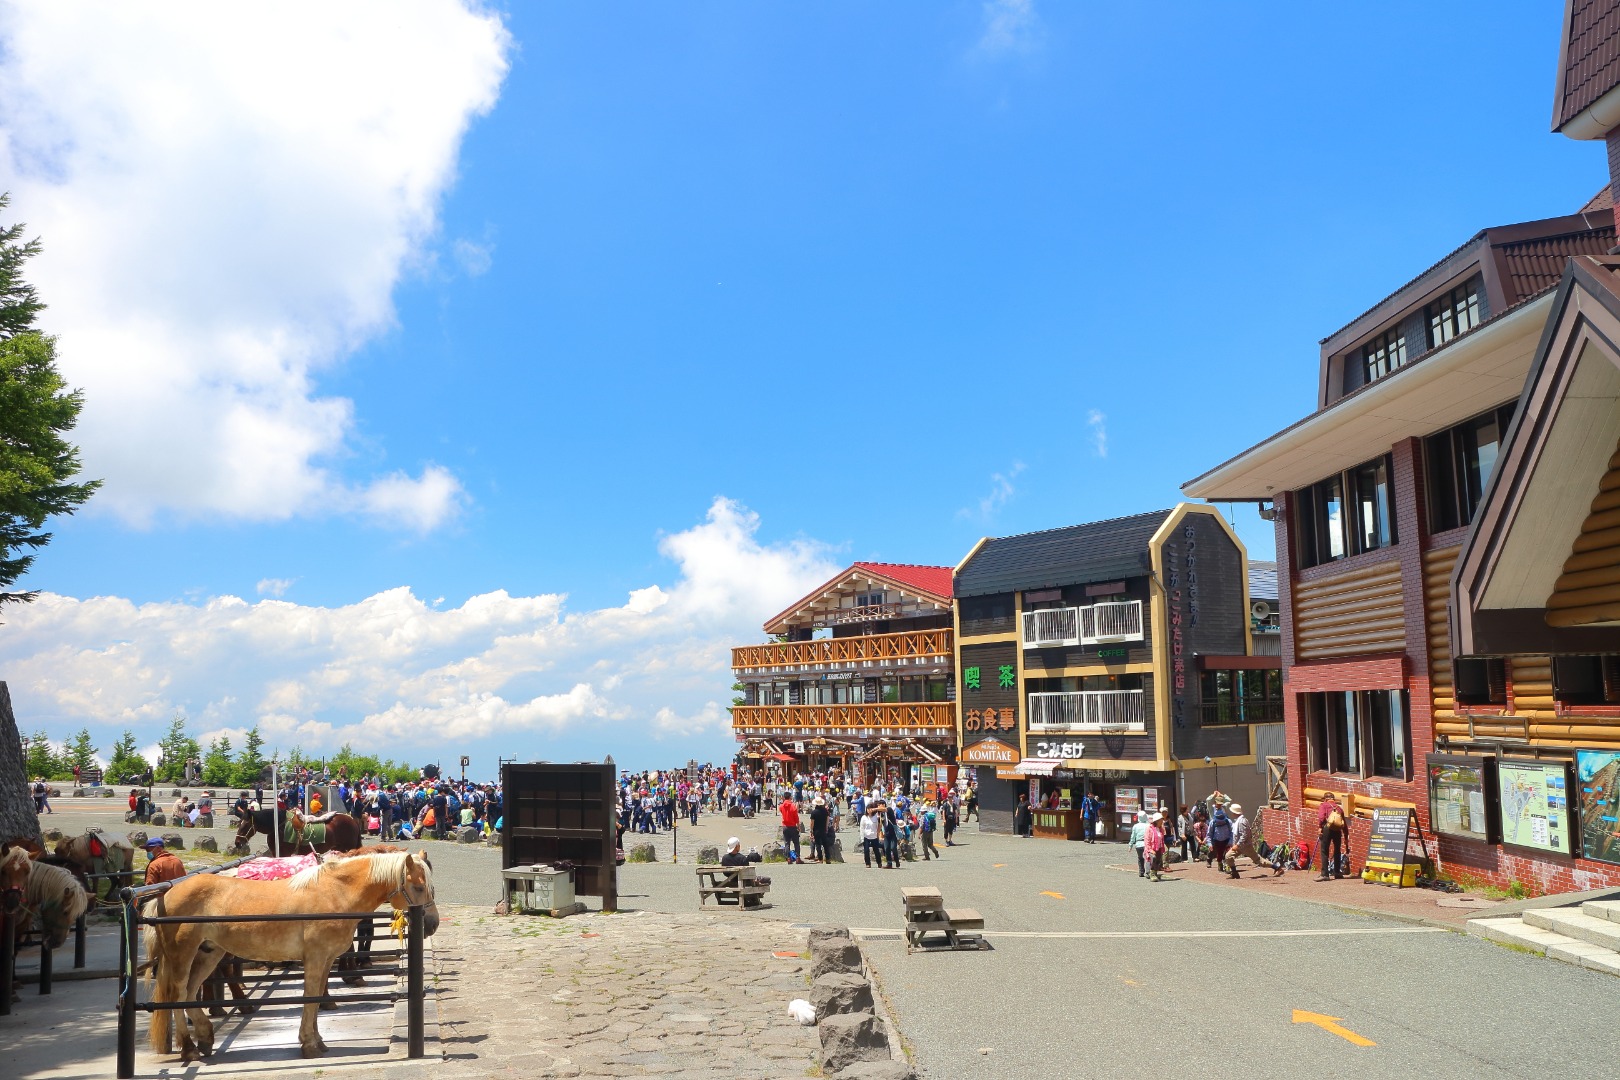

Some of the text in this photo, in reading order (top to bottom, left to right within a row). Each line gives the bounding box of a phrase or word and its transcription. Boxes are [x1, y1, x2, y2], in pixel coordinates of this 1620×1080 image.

[1097, 648, 1125, 658] COFFEE
[964, 665, 1015, 689] 喫茶
[965, 707, 1015, 731] お食事
[969, 750, 1012, 761] KOMITAKE
[1037, 742, 1085, 759] こみたけ
